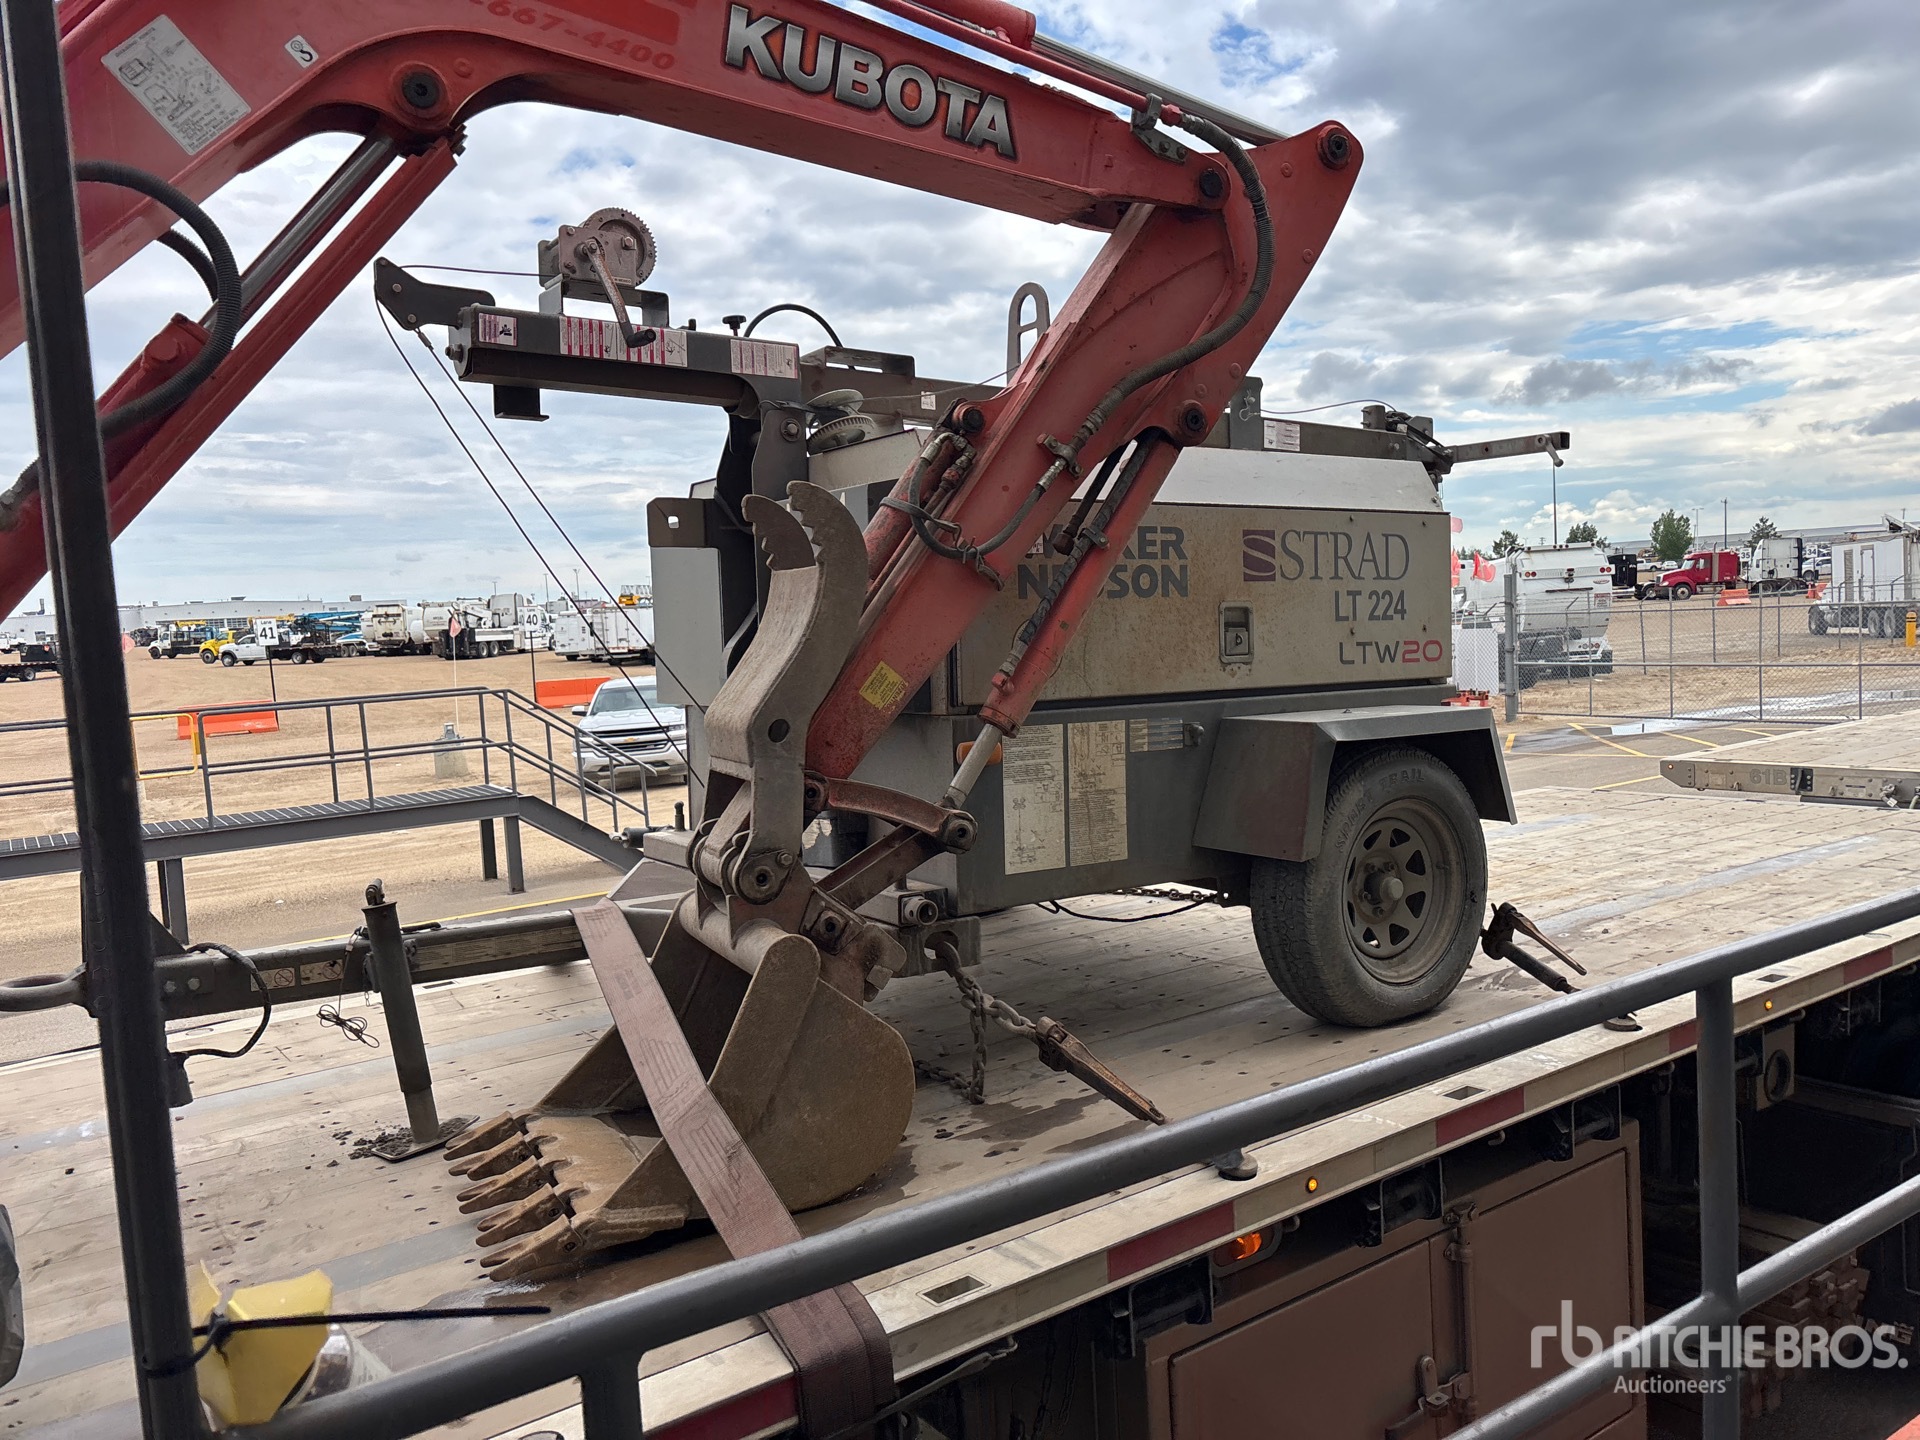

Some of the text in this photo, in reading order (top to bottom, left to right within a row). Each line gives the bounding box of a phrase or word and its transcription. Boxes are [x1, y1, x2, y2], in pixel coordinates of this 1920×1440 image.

[723, 3, 1017, 159] KUBOTA
[1280, 528, 1411, 582] STRAD
[1017, 564, 1189, 599] NSON
[525, 613, 538, 625] 40
[1334, 589, 1407, 622] LT 224
[259, 626, 277, 640] 41
[1338, 639, 1443, 665] LTW20
[1749, 768, 1788, 786] 61B
